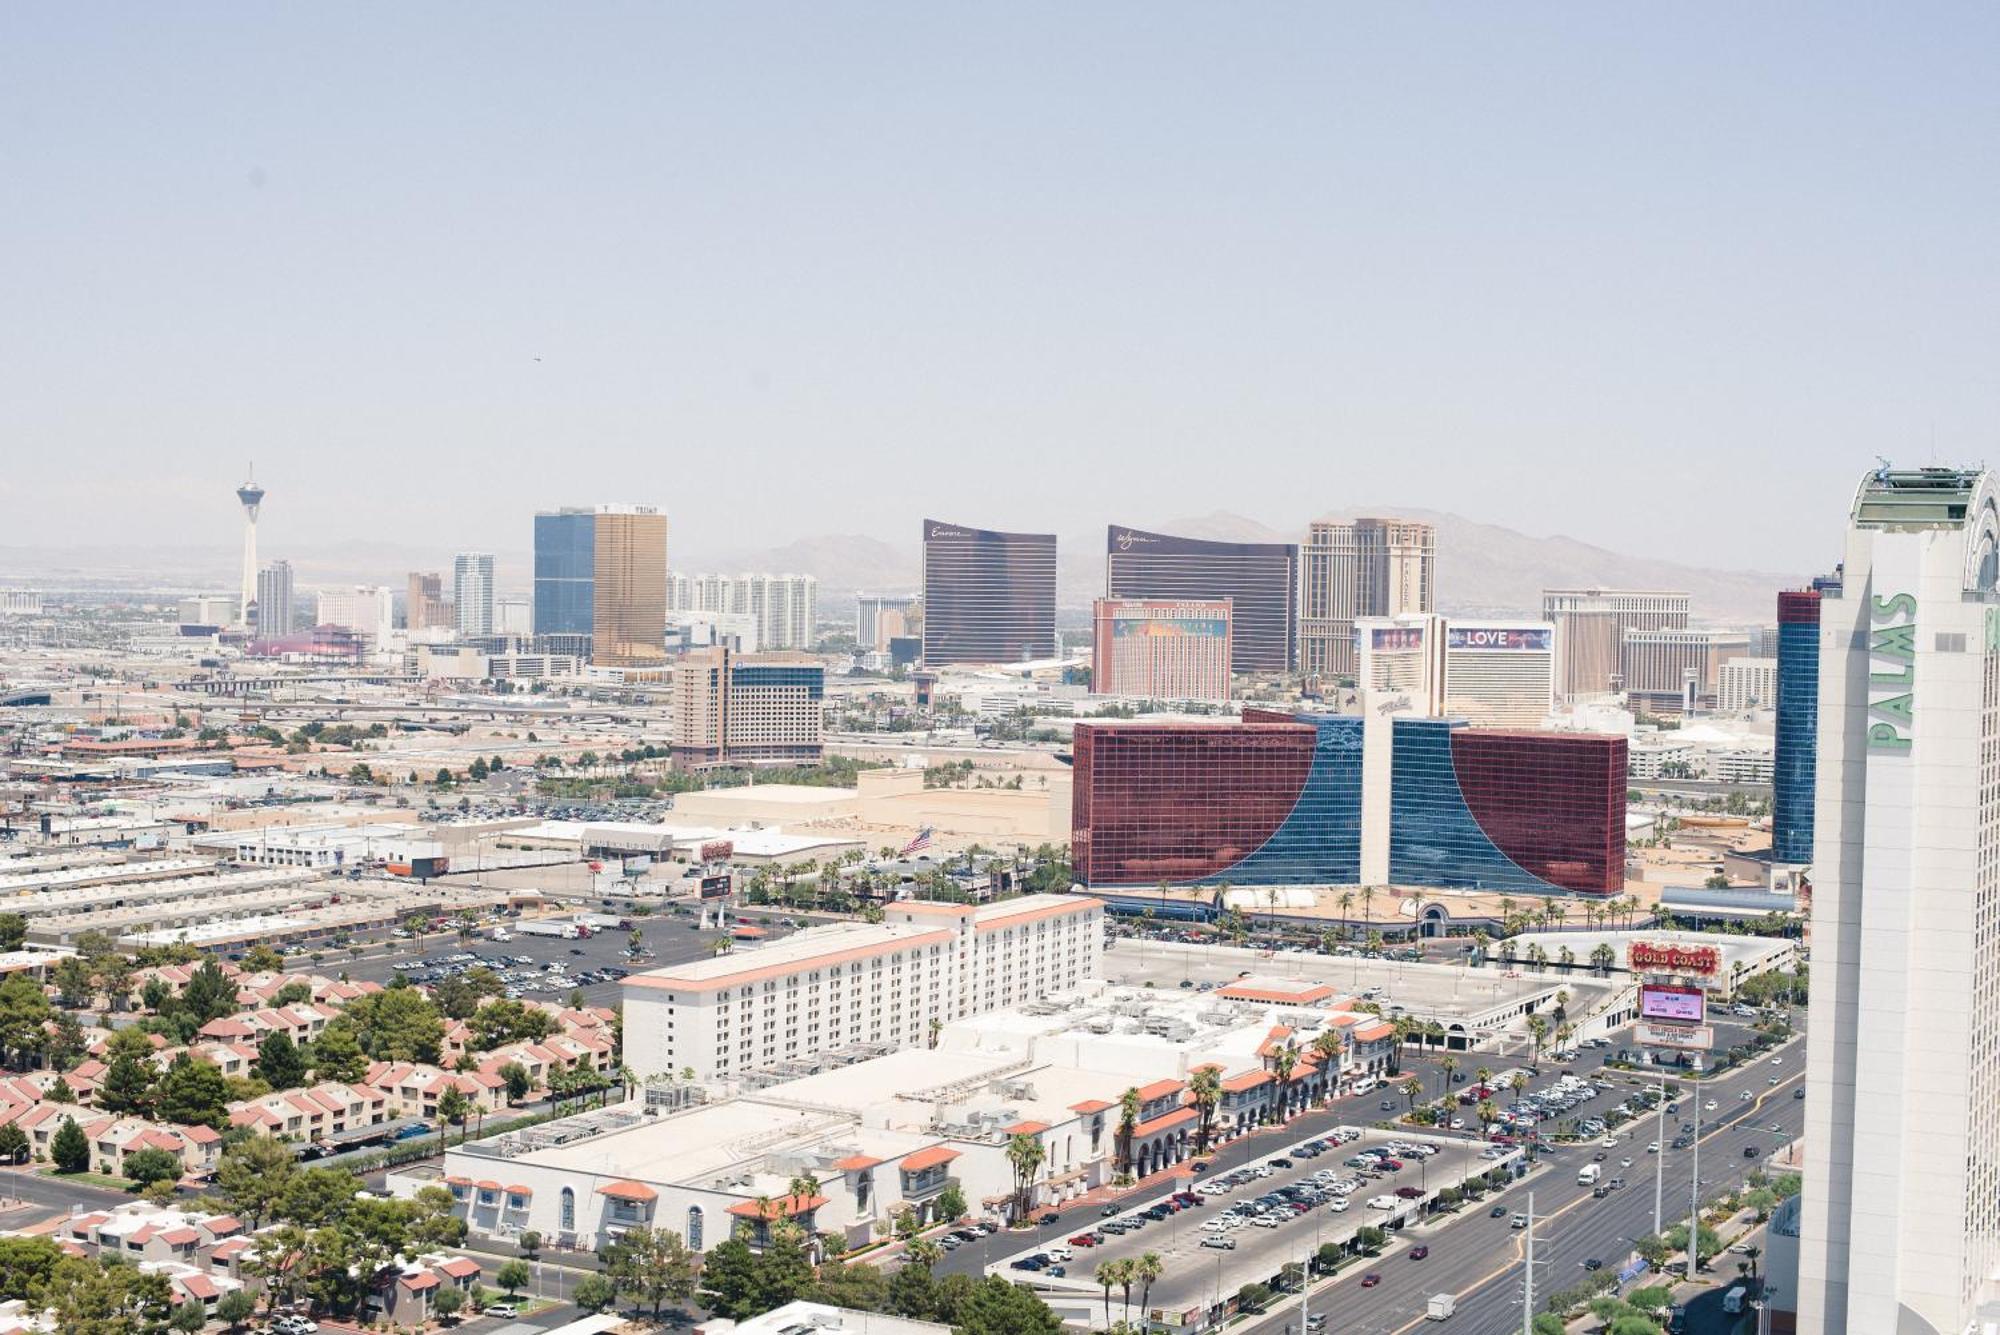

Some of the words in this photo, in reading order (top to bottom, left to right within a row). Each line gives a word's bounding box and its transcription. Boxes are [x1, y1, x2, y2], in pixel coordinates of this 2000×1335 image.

[1467, 632, 1507, 645] LOVE
[1869, 592, 1917, 749] PALMS
[1635, 952, 1668, 964] GOLD
[1672, 955, 1712, 968] COAST
